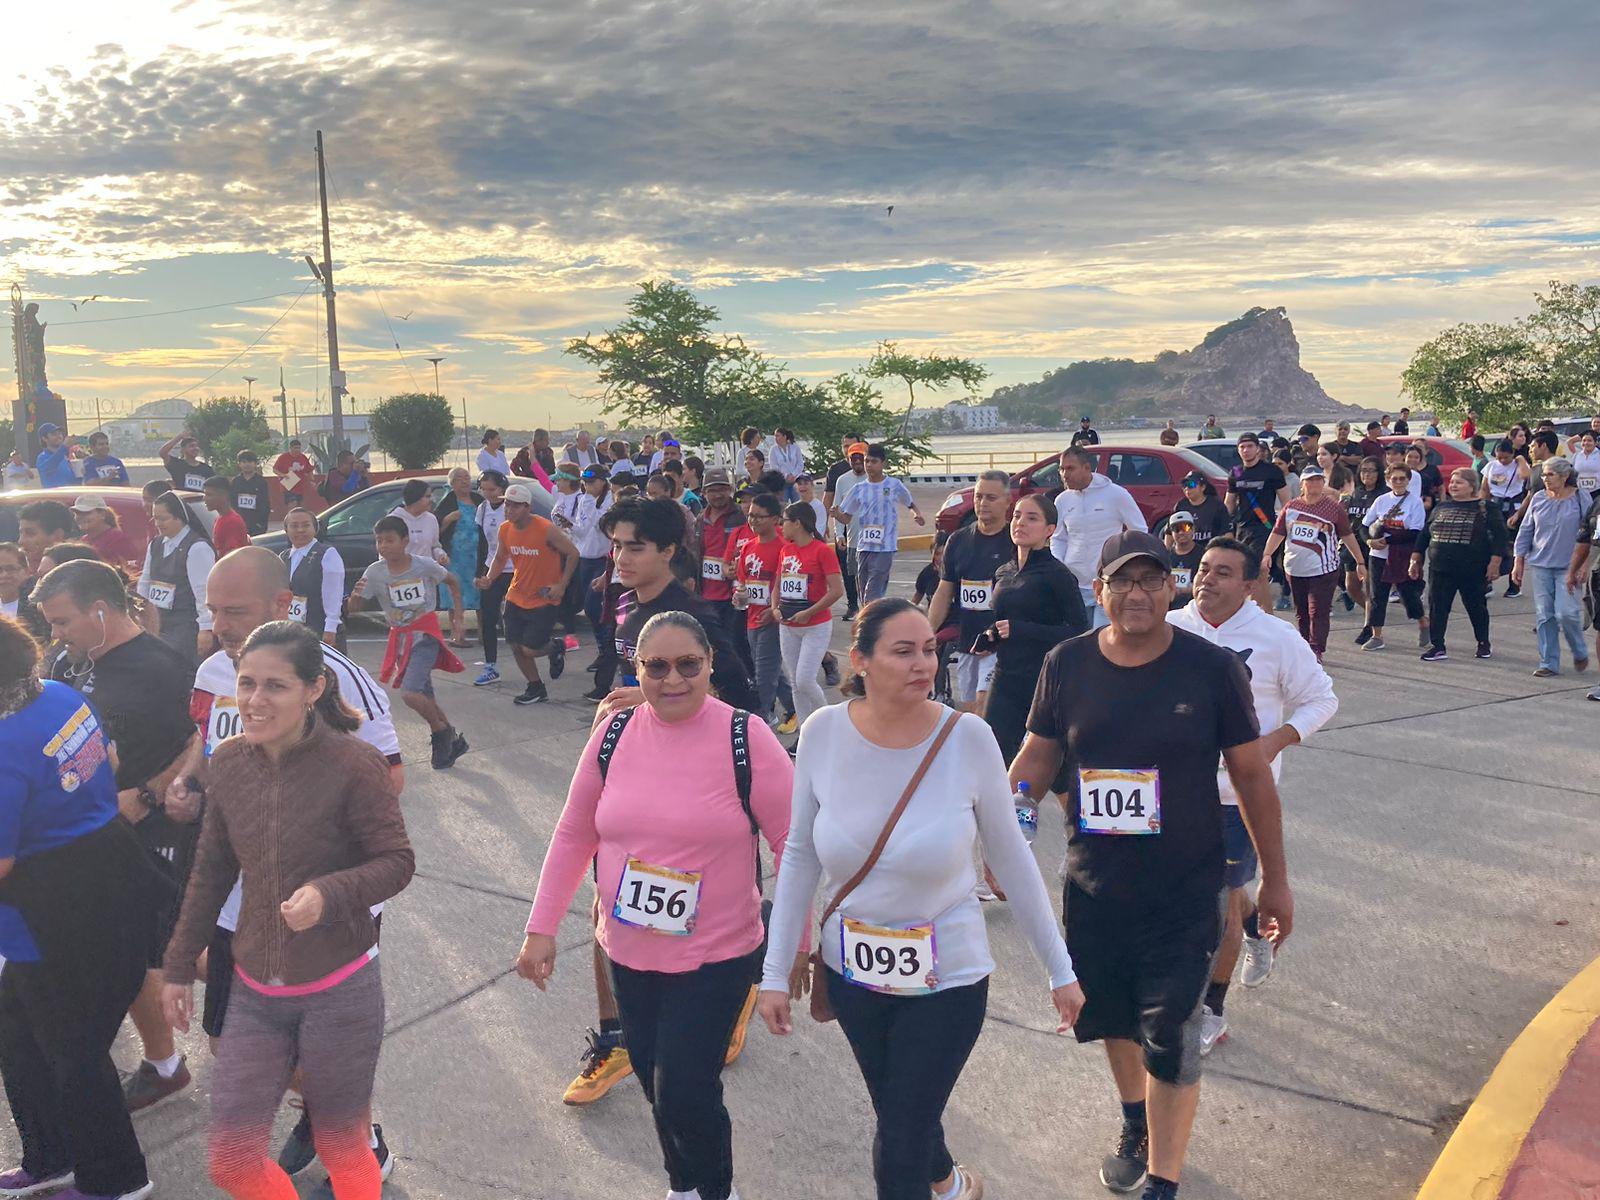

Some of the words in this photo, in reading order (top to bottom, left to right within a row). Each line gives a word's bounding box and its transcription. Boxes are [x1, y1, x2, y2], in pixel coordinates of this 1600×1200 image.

[187, 479, 202, 487] 031
[240, 497, 253, 505] 120
[865, 530, 881, 539] 162
[1294, 526, 1314, 538] 058
[703, 562, 720, 575] 083
[394, 586, 422, 602] 161
[782, 580, 802, 593] 084
[150, 587, 170, 602] 027
[962, 588, 987, 604] 069
[600, 713, 627, 761] BOSSY
[734, 716, 747, 767] SWEET
[1088, 788, 1145, 818] 104
[626, 880, 688, 919] 156
[855, 941, 920, 977] 093
